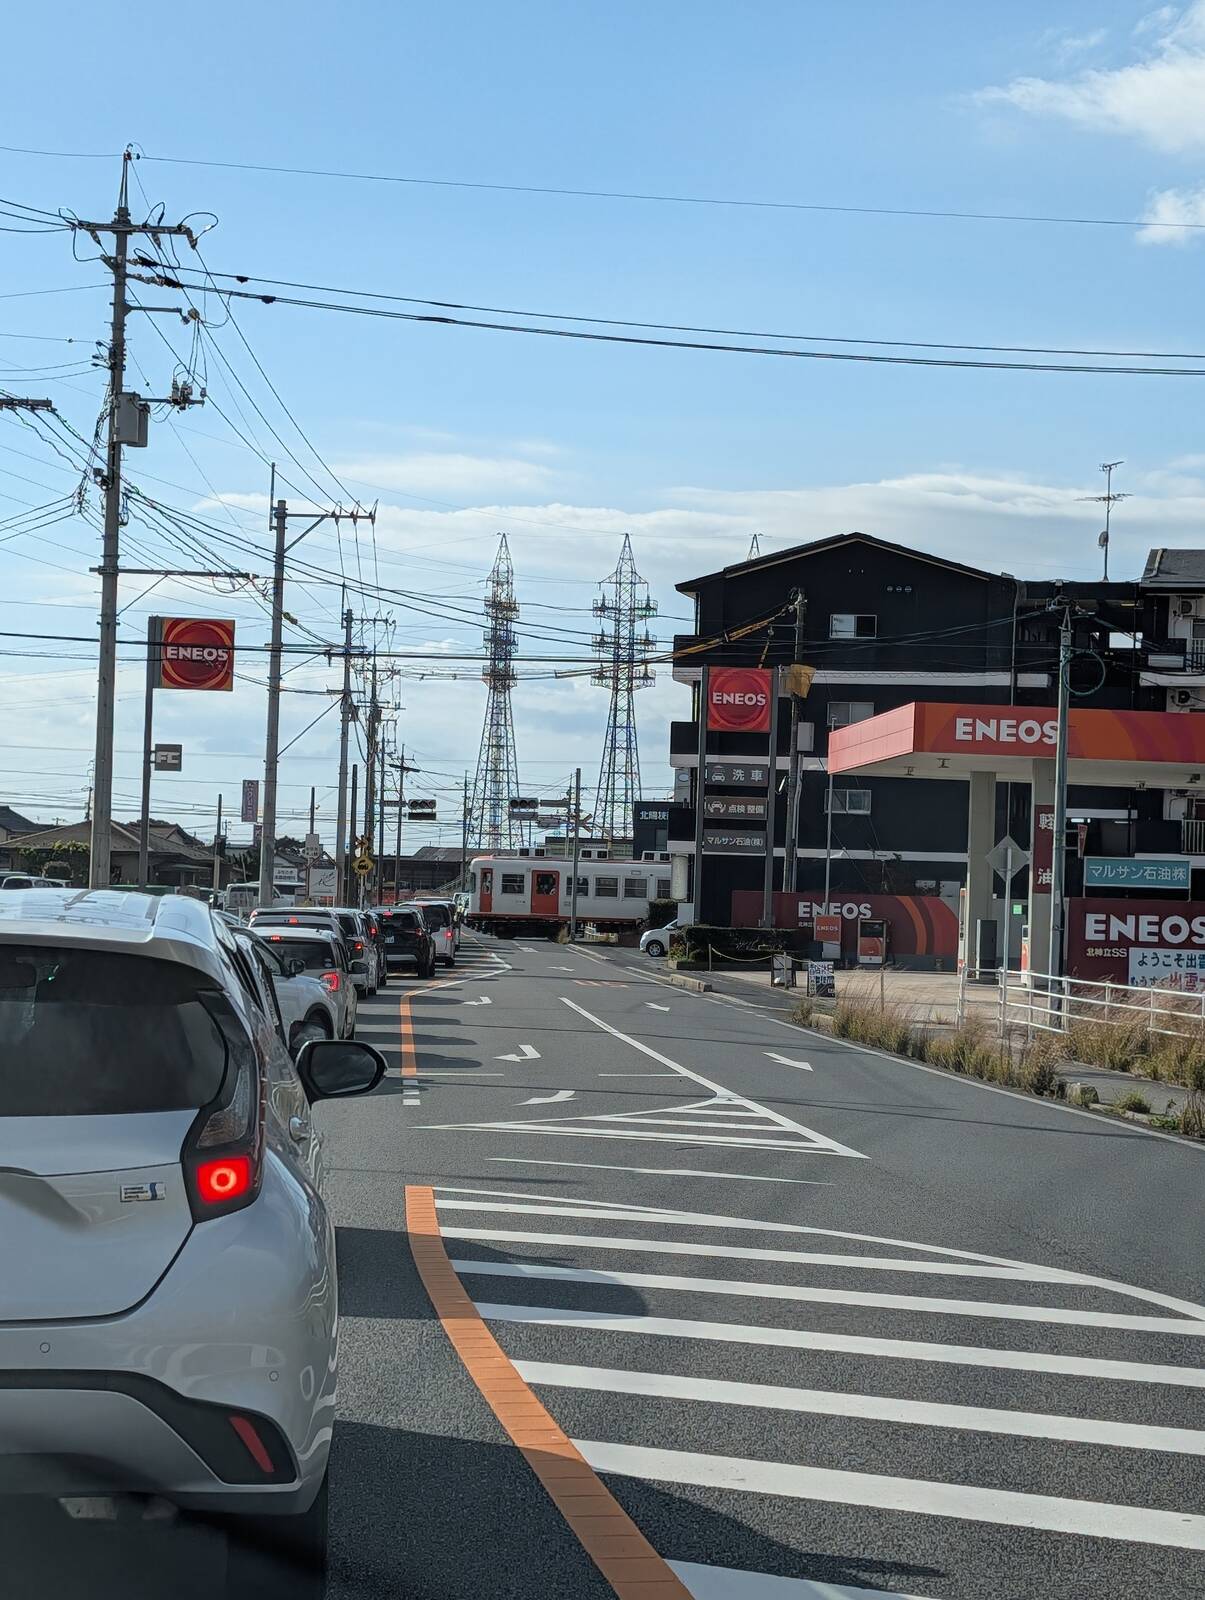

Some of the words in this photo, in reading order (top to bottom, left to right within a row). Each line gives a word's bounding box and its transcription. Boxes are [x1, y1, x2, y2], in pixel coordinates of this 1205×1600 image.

[166, 645, 229, 661] ENEOS
[712, 691, 766, 706] ENEOS
[955, 717, 1058, 745] ENEOS
[732, 769, 763, 781] 洗車
[798, 901, 872, 920] ENEOS
[1085, 913, 1205, 944] ENEOS
